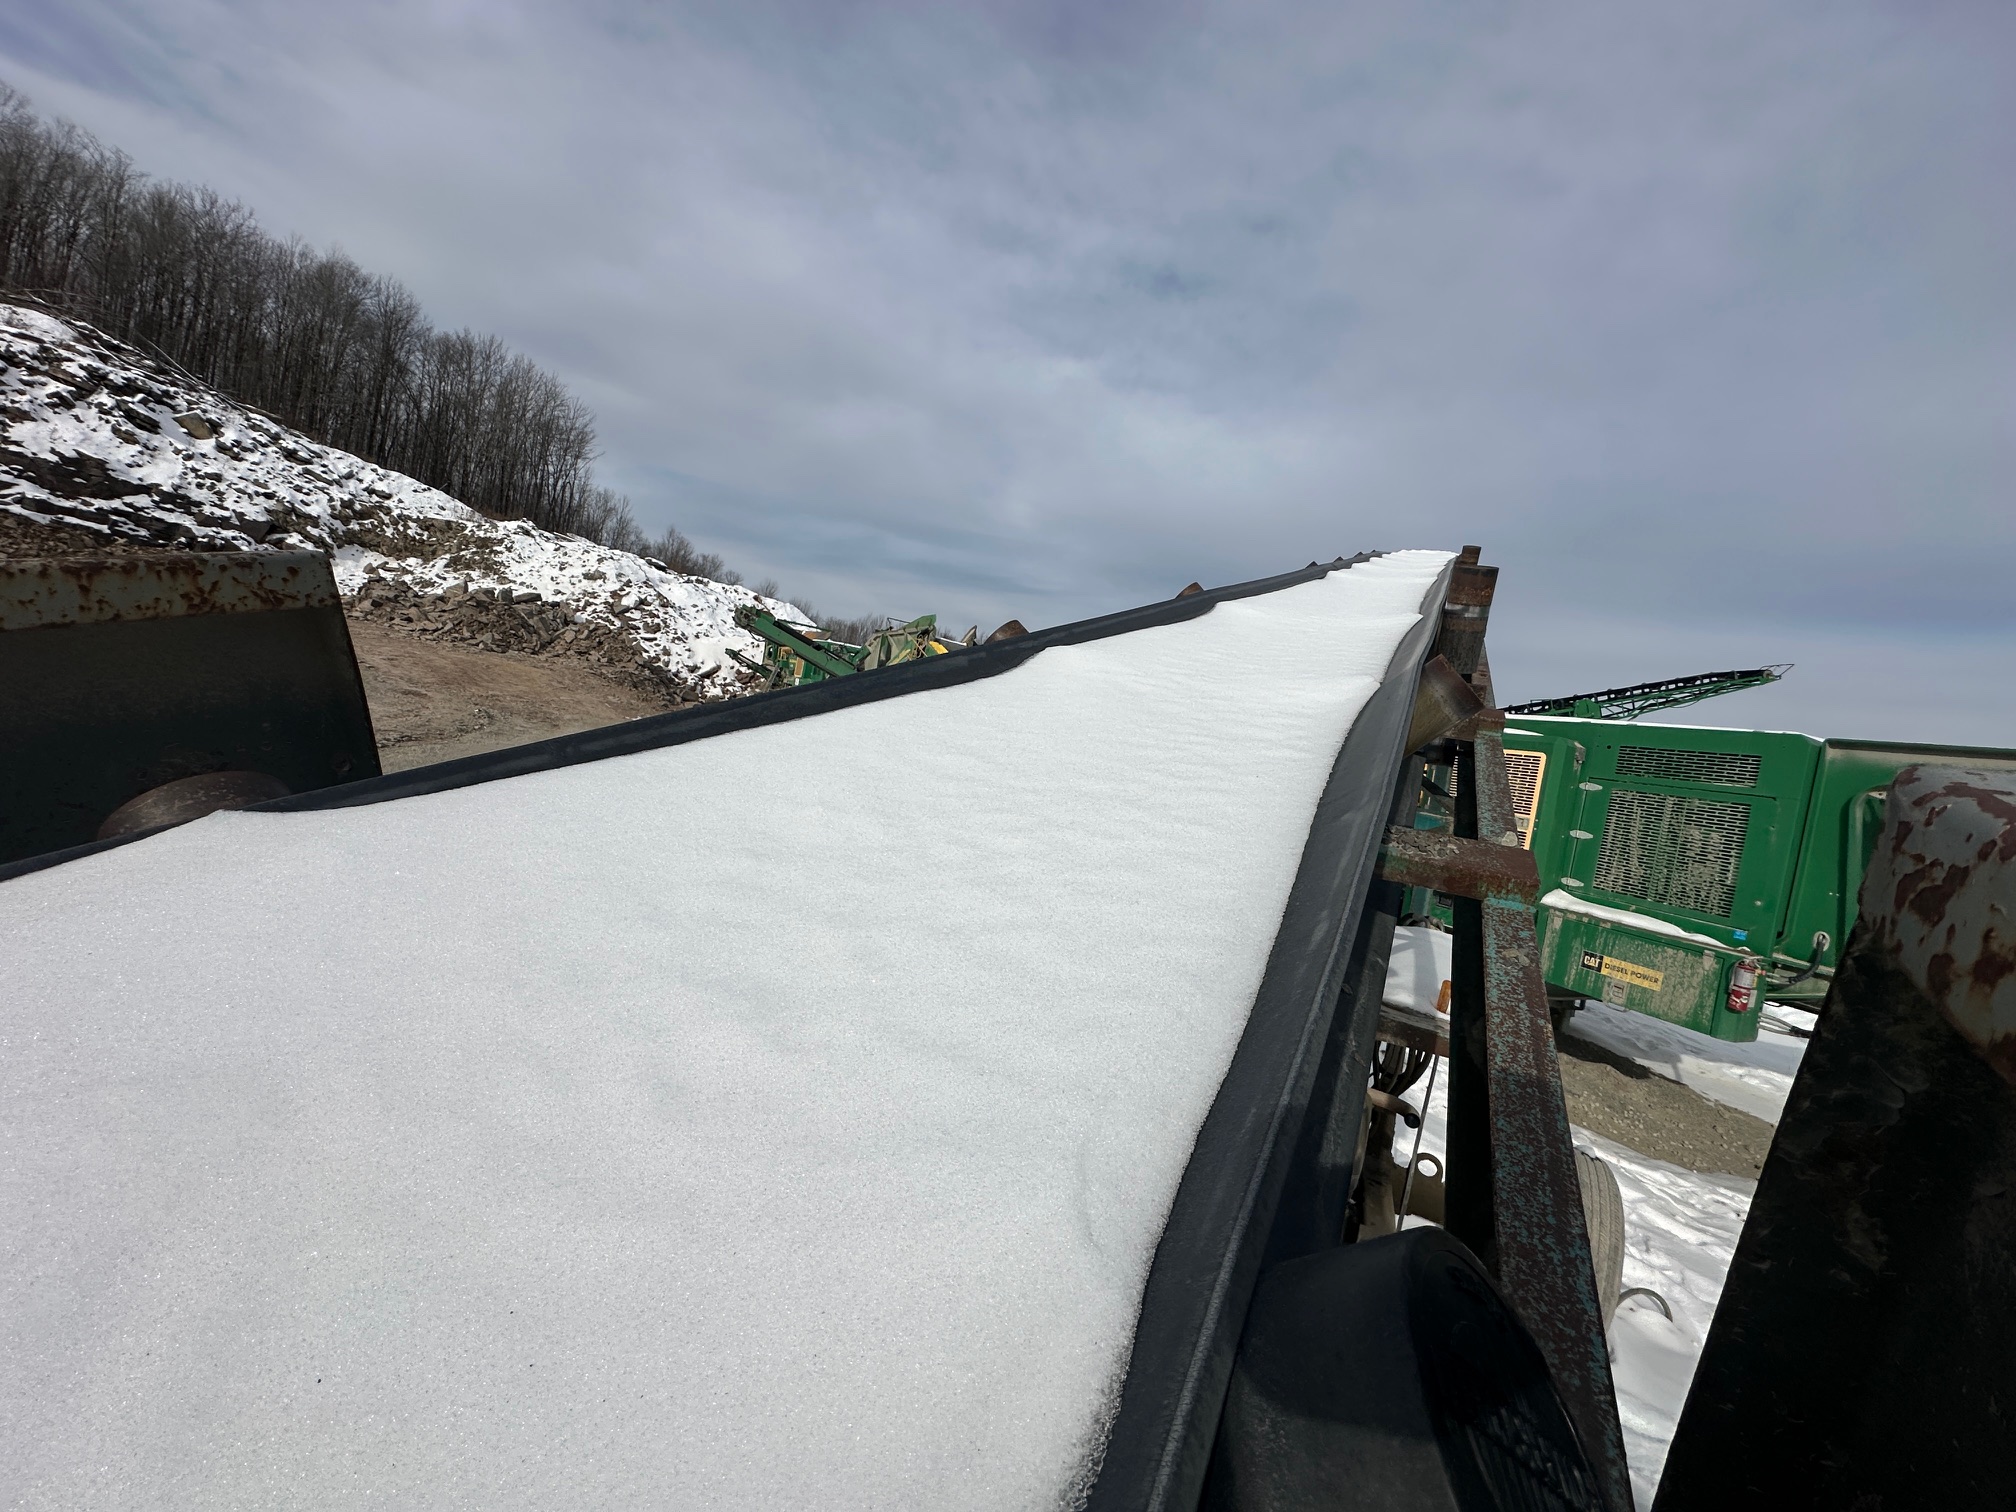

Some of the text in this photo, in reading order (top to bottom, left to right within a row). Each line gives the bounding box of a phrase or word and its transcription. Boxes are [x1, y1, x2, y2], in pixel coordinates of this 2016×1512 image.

[1584, 955, 1601, 968] CAT
[1604, 963, 1659, 984] DIESEL POWER
